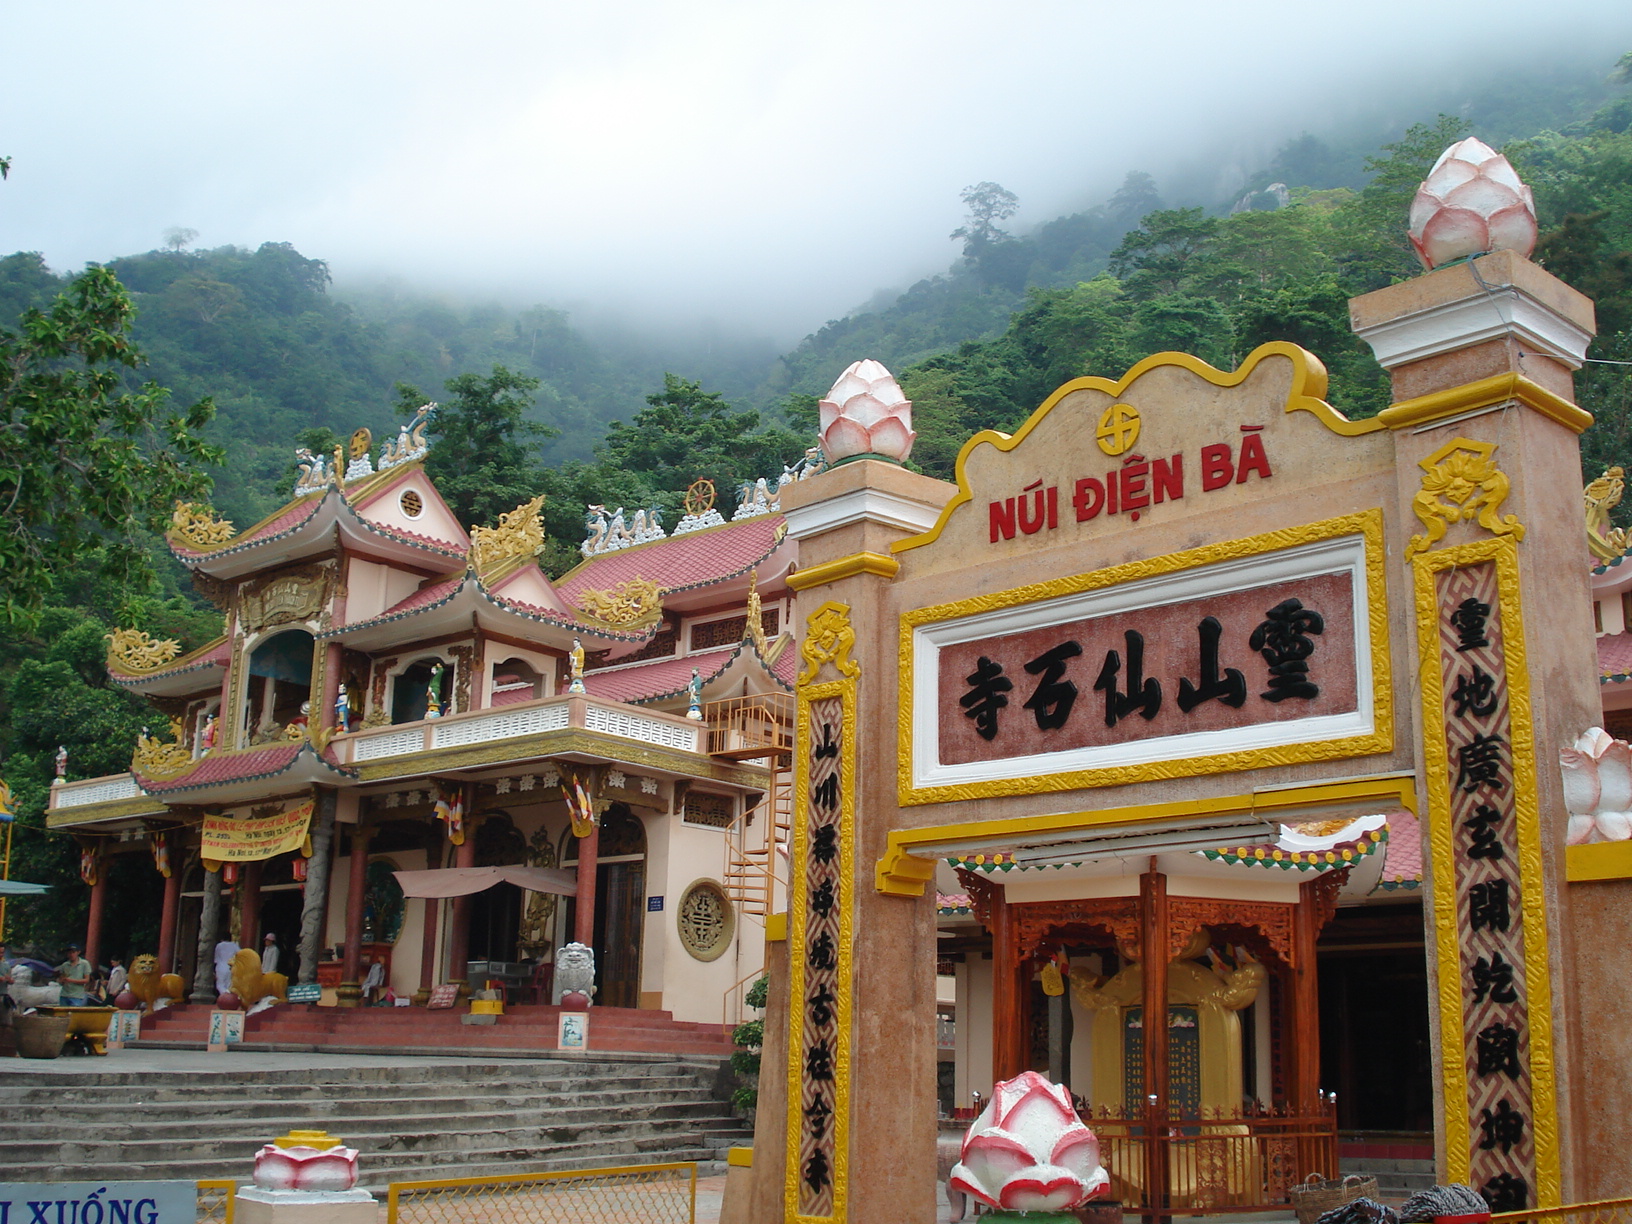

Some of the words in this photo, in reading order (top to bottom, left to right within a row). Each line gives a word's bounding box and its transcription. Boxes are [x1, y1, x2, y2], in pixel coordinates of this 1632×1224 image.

[989, 478, 1058, 543] NÚI
[1073, 454, 1184, 523] ĐIỆN
[26, 1186, 159, 1224] XUỐNG
